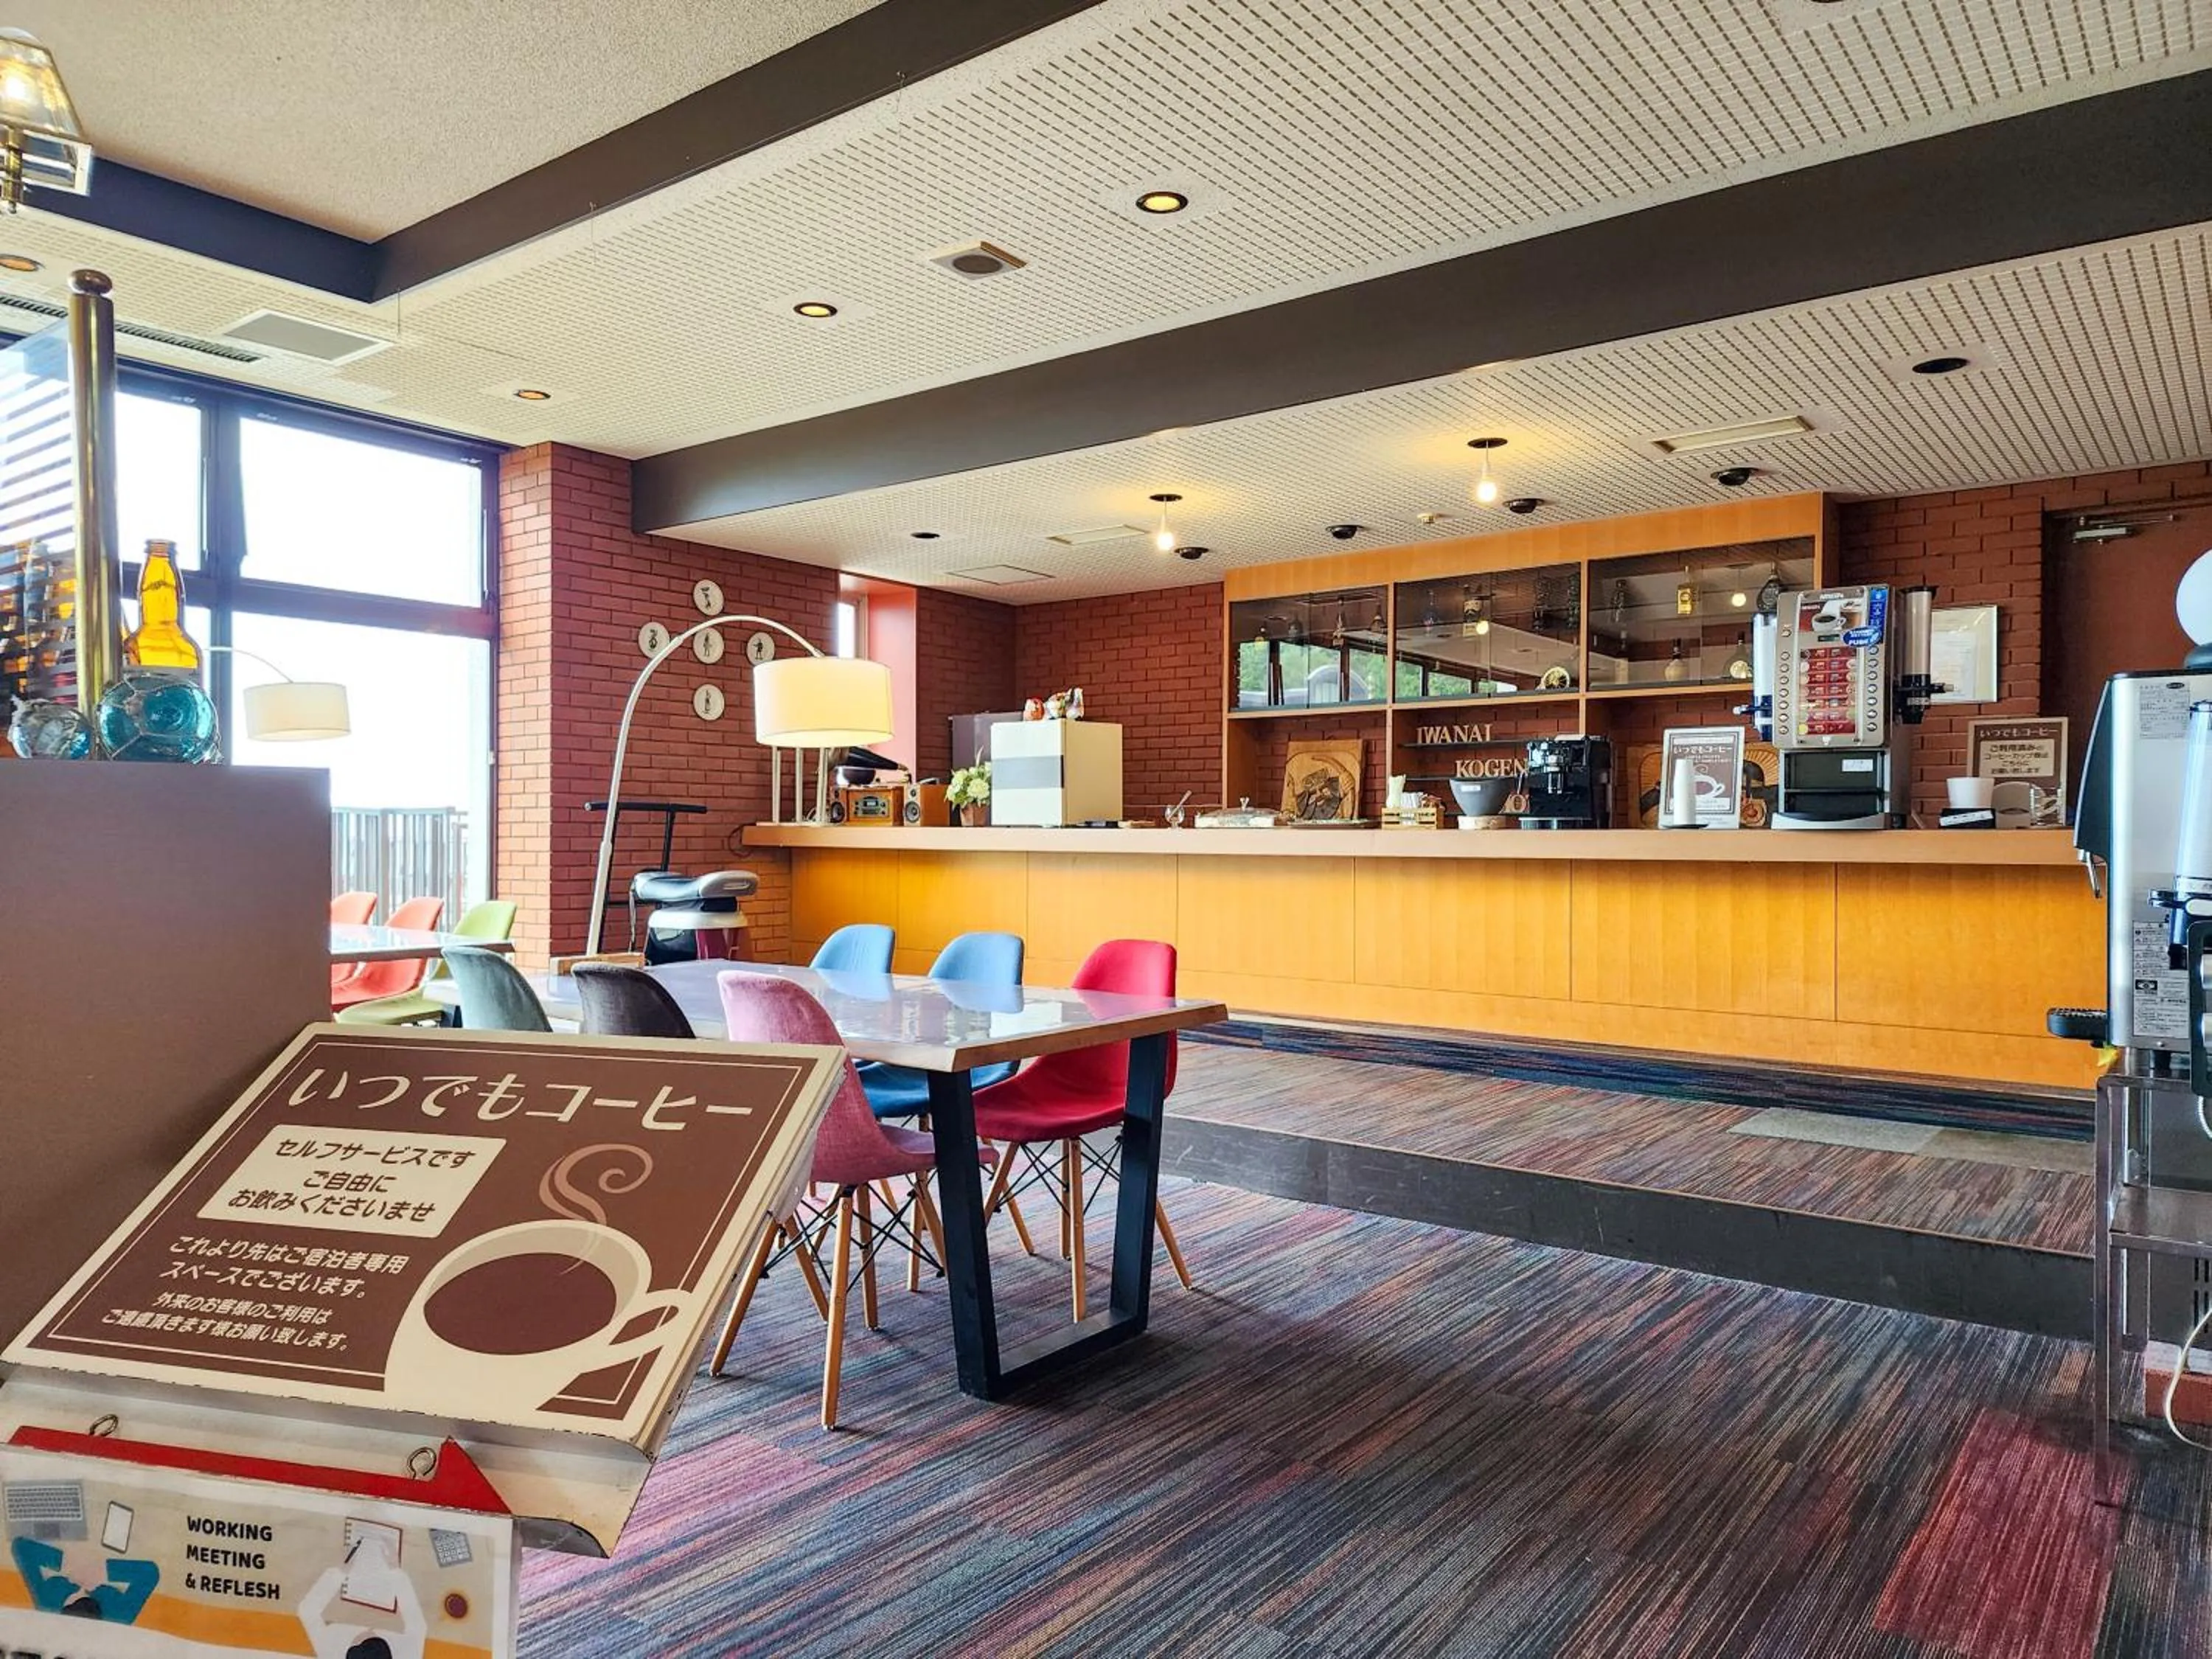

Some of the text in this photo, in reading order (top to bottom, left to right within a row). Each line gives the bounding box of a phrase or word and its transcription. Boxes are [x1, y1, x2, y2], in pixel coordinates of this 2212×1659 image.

[1416, 723, 1493, 744] IWANAI
[1455, 758, 1528, 778] KOGEN
[287, 1067, 754, 1132] いつでもコーヒー
[276, 1138, 477, 1169] セルフサービスです
[302, 1171, 397, 1194] ご自由に
[227, 1188, 437, 1222] お飲みくださいませ
[169, 1235, 411, 1275] これより先はご宿泊者専用
[159, 1261, 366, 1298] スペースでございます。
[153, 1292, 334, 1325] 外来のお客様のご利用は
[101, 1308, 349, 1352] ご遠慮頂きます様お願い致します。
[187, 1515, 273, 1542] WORKING
[187, 1545, 266, 1570] MEETING
[185, 1573, 280, 1600] & REFLESH
